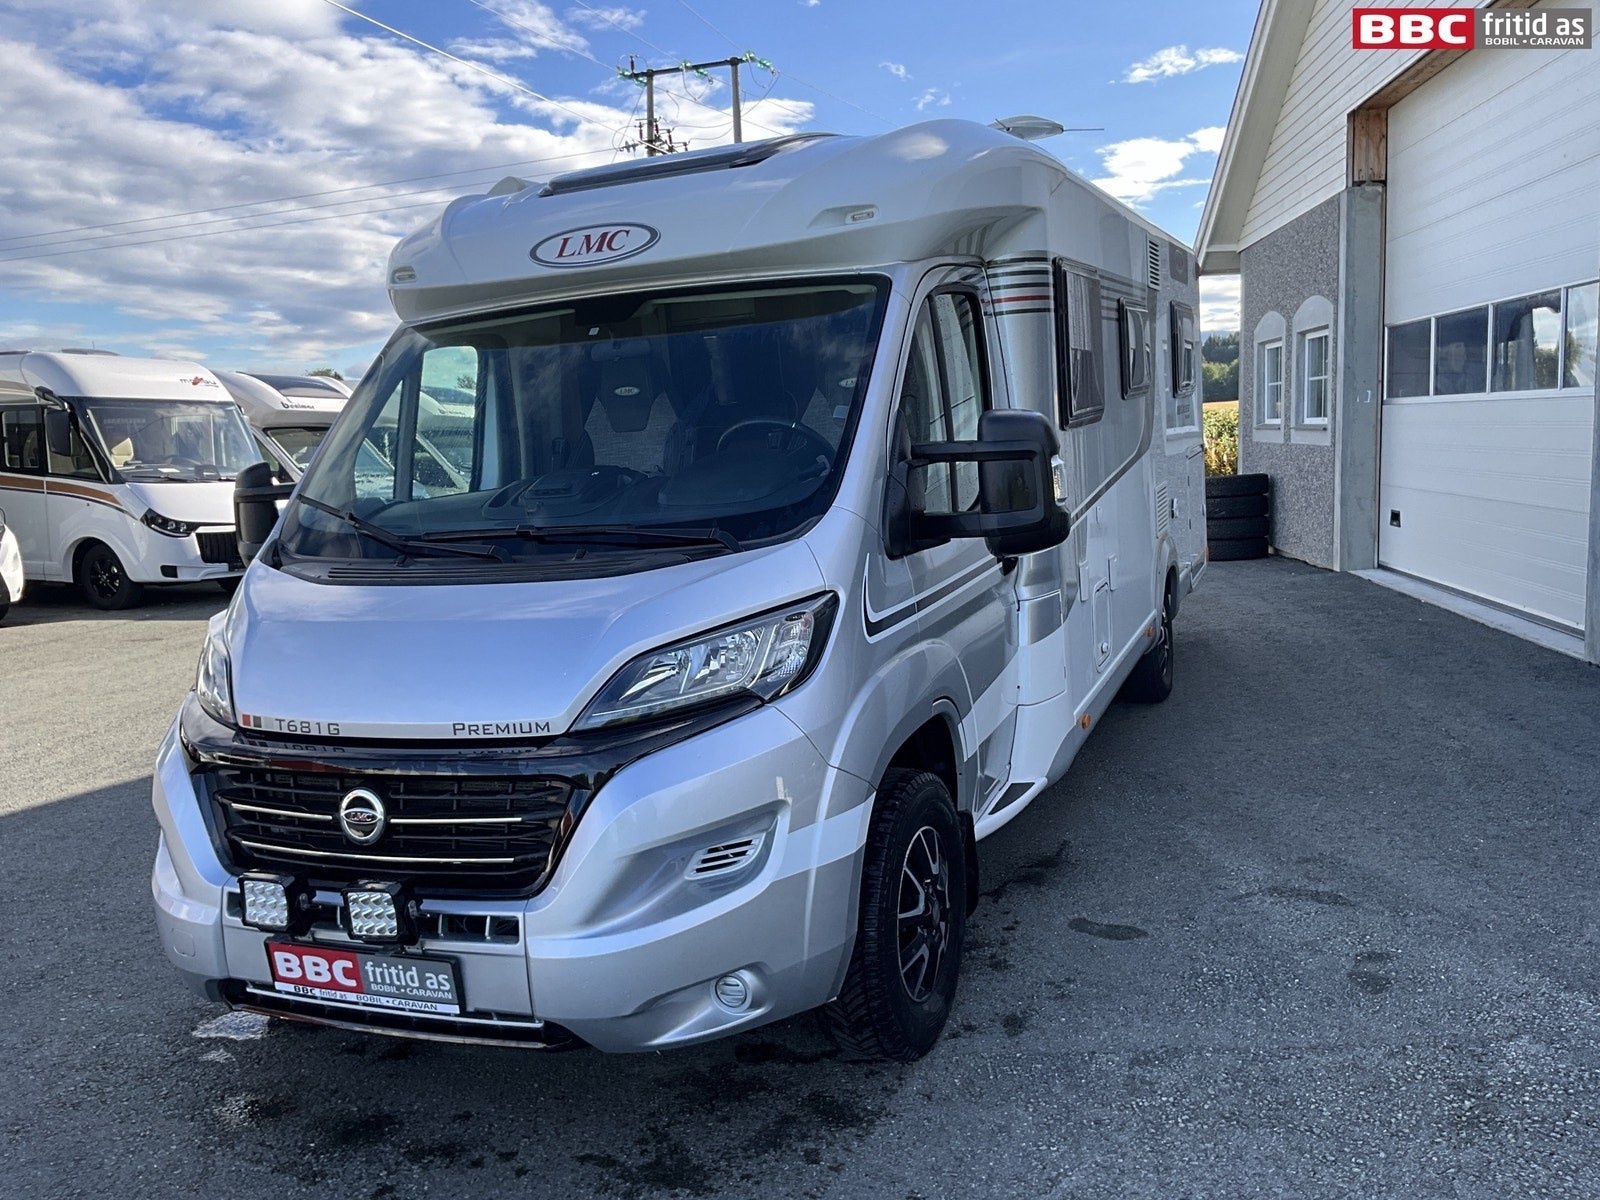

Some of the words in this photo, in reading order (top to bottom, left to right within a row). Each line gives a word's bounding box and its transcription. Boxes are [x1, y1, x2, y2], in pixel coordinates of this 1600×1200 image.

[555, 229, 631, 259] LMC
[275, 718, 340, 735] T681G
[452, 721, 551, 736] PREMIUM
[350, 812, 372, 822] LMC
[273, 951, 358, 987] BBC
[364, 961, 419, 988] fritid
[425, 972, 451, 991] as
[293, 986, 316, 997] BBC
[319, 988, 337, 999] fritid
[338, 992, 348, 1000] as
[356, 994, 382, 1005] BOBIL
[392, 999, 438, 1011] CARAVAN
[371, 983, 400, 994] BOBIL
[406, 987, 452, 1000] CARAVAN
